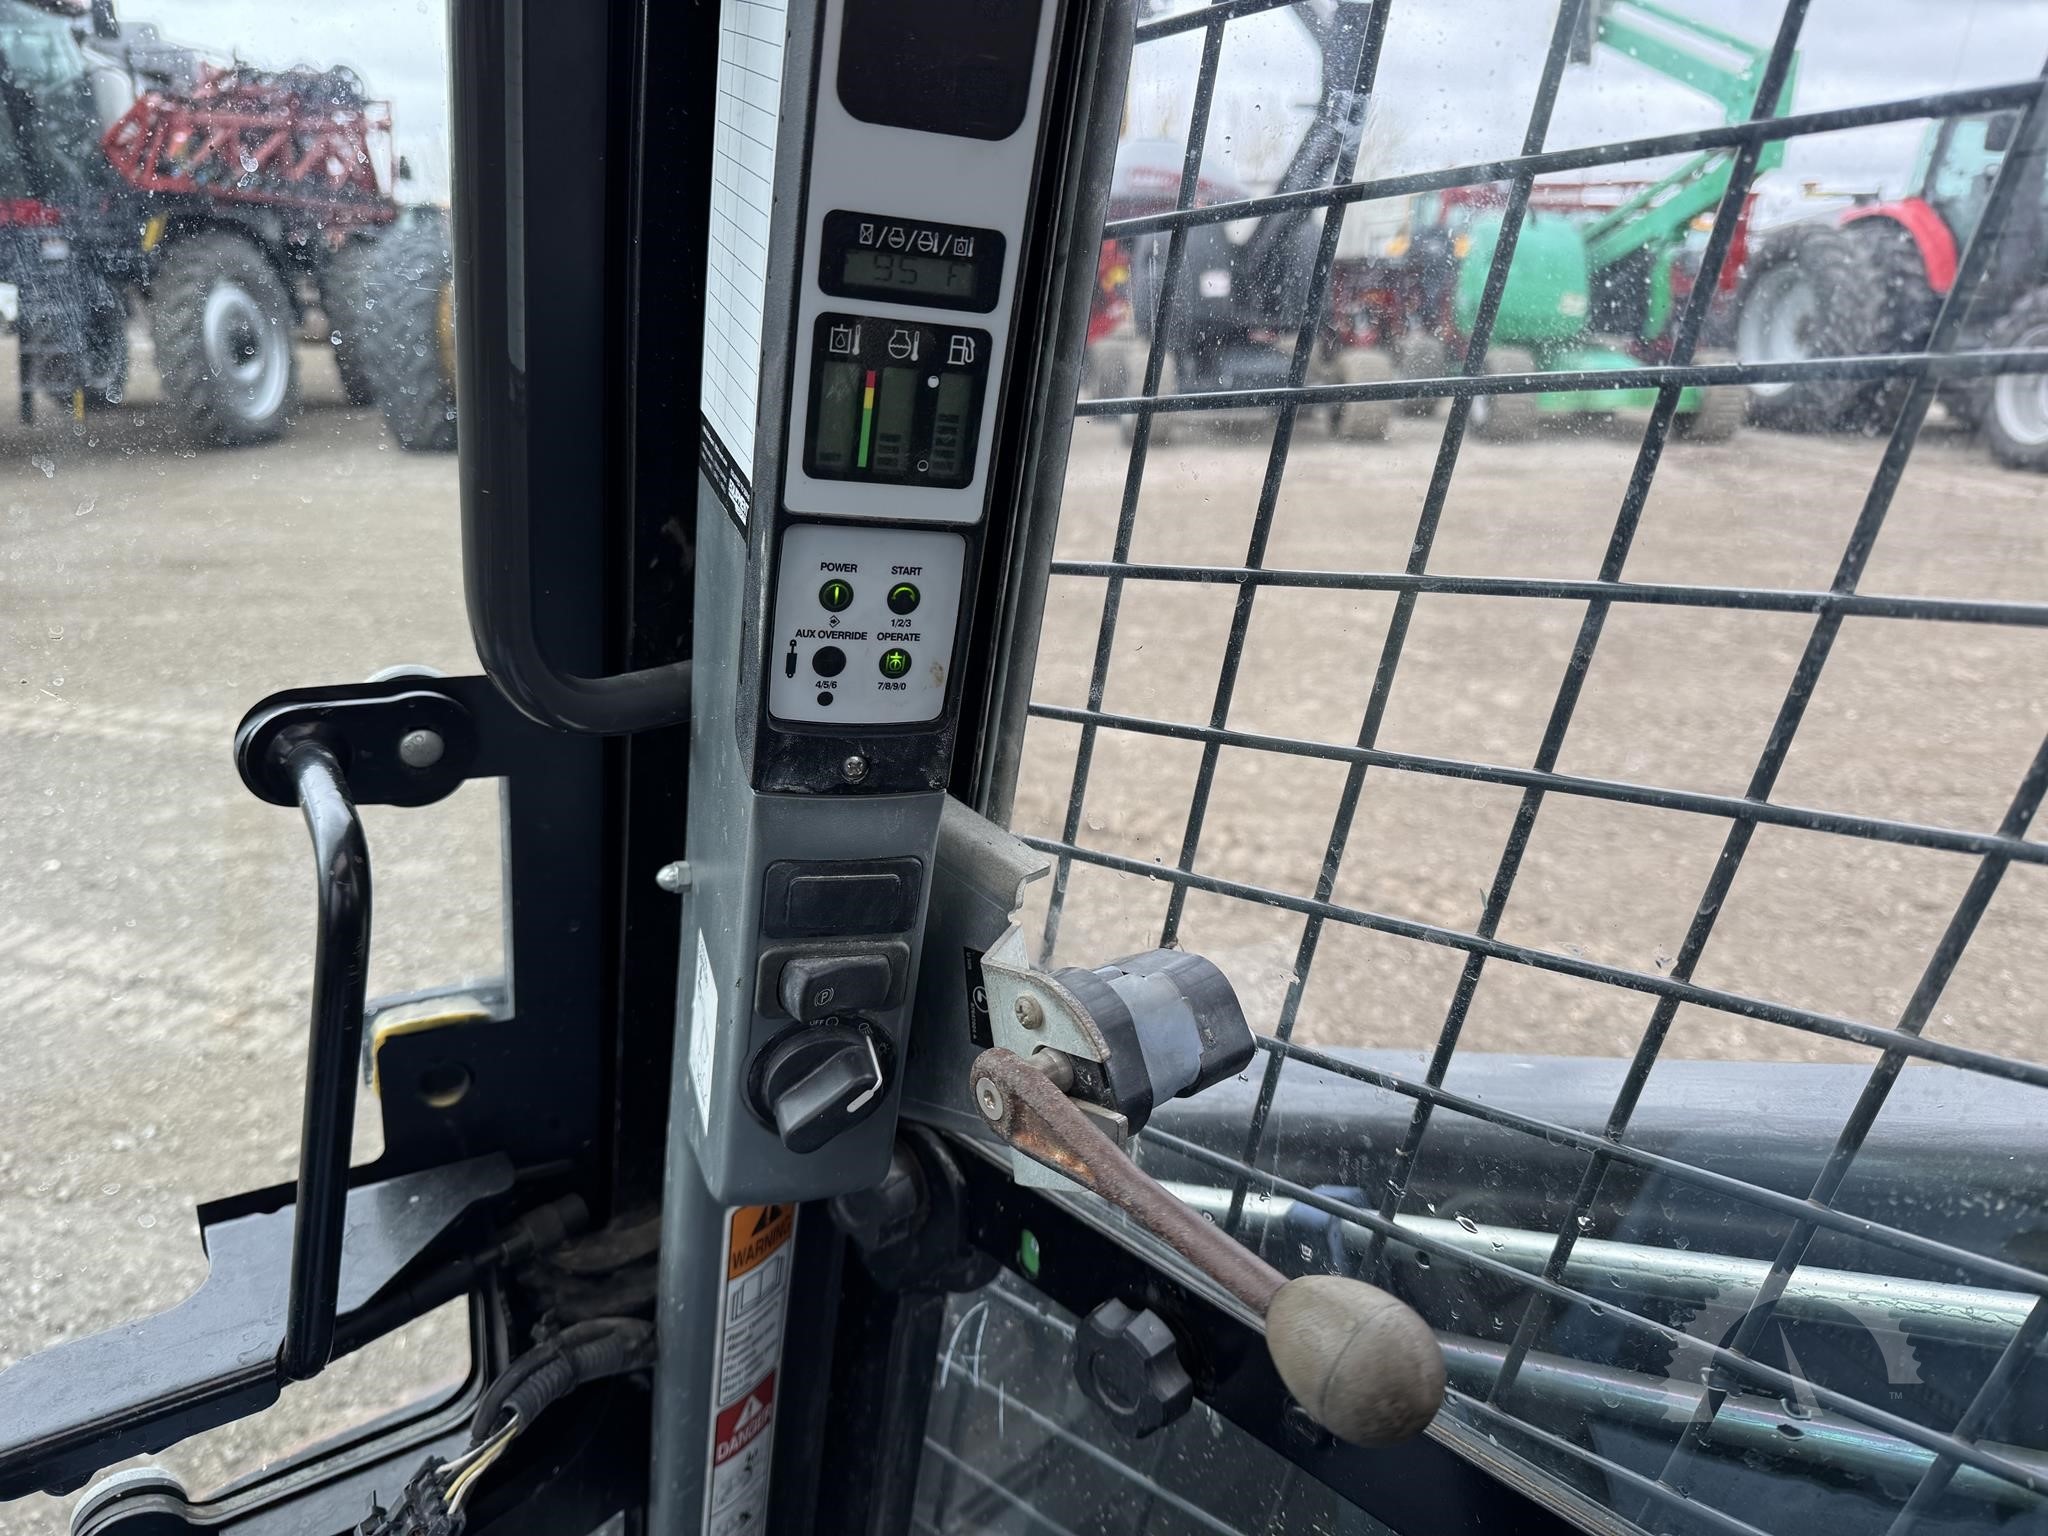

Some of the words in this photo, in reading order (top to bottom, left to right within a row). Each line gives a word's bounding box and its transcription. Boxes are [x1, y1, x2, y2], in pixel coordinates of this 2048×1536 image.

[820, 562, 858, 573] POWER
[891, 566, 922, 576] START
[891, 619, 912, 628] 1/2/3
[795, 629, 816, 639] AUX
[818, 631, 868, 641] OVERRIDE
[877, 632, 921, 642] OPERATE
[815, 680, 838, 689] 4/5/6
[877, 682, 907, 691] 7/8/9/0
[732, 1215, 792, 1269] WARNING
[717, 1402, 773, 1462] DANGER
